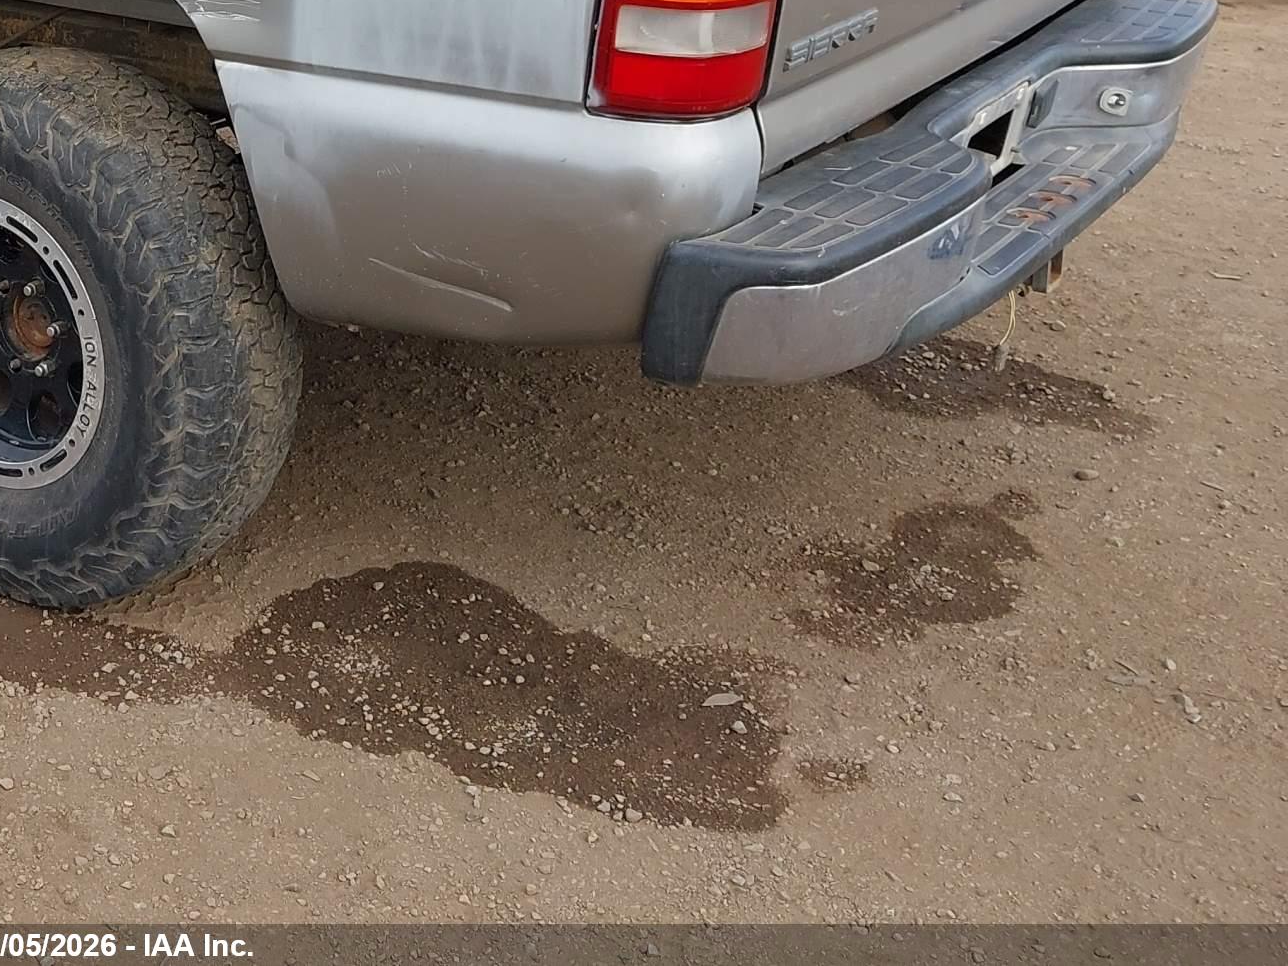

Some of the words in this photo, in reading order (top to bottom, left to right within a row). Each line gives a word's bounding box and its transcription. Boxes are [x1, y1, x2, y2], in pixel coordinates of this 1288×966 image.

[783, 8, 879, 72] SIERRA
[82, 336, 97, 368] ION
[78, 380, 98, 438] ALLOY
